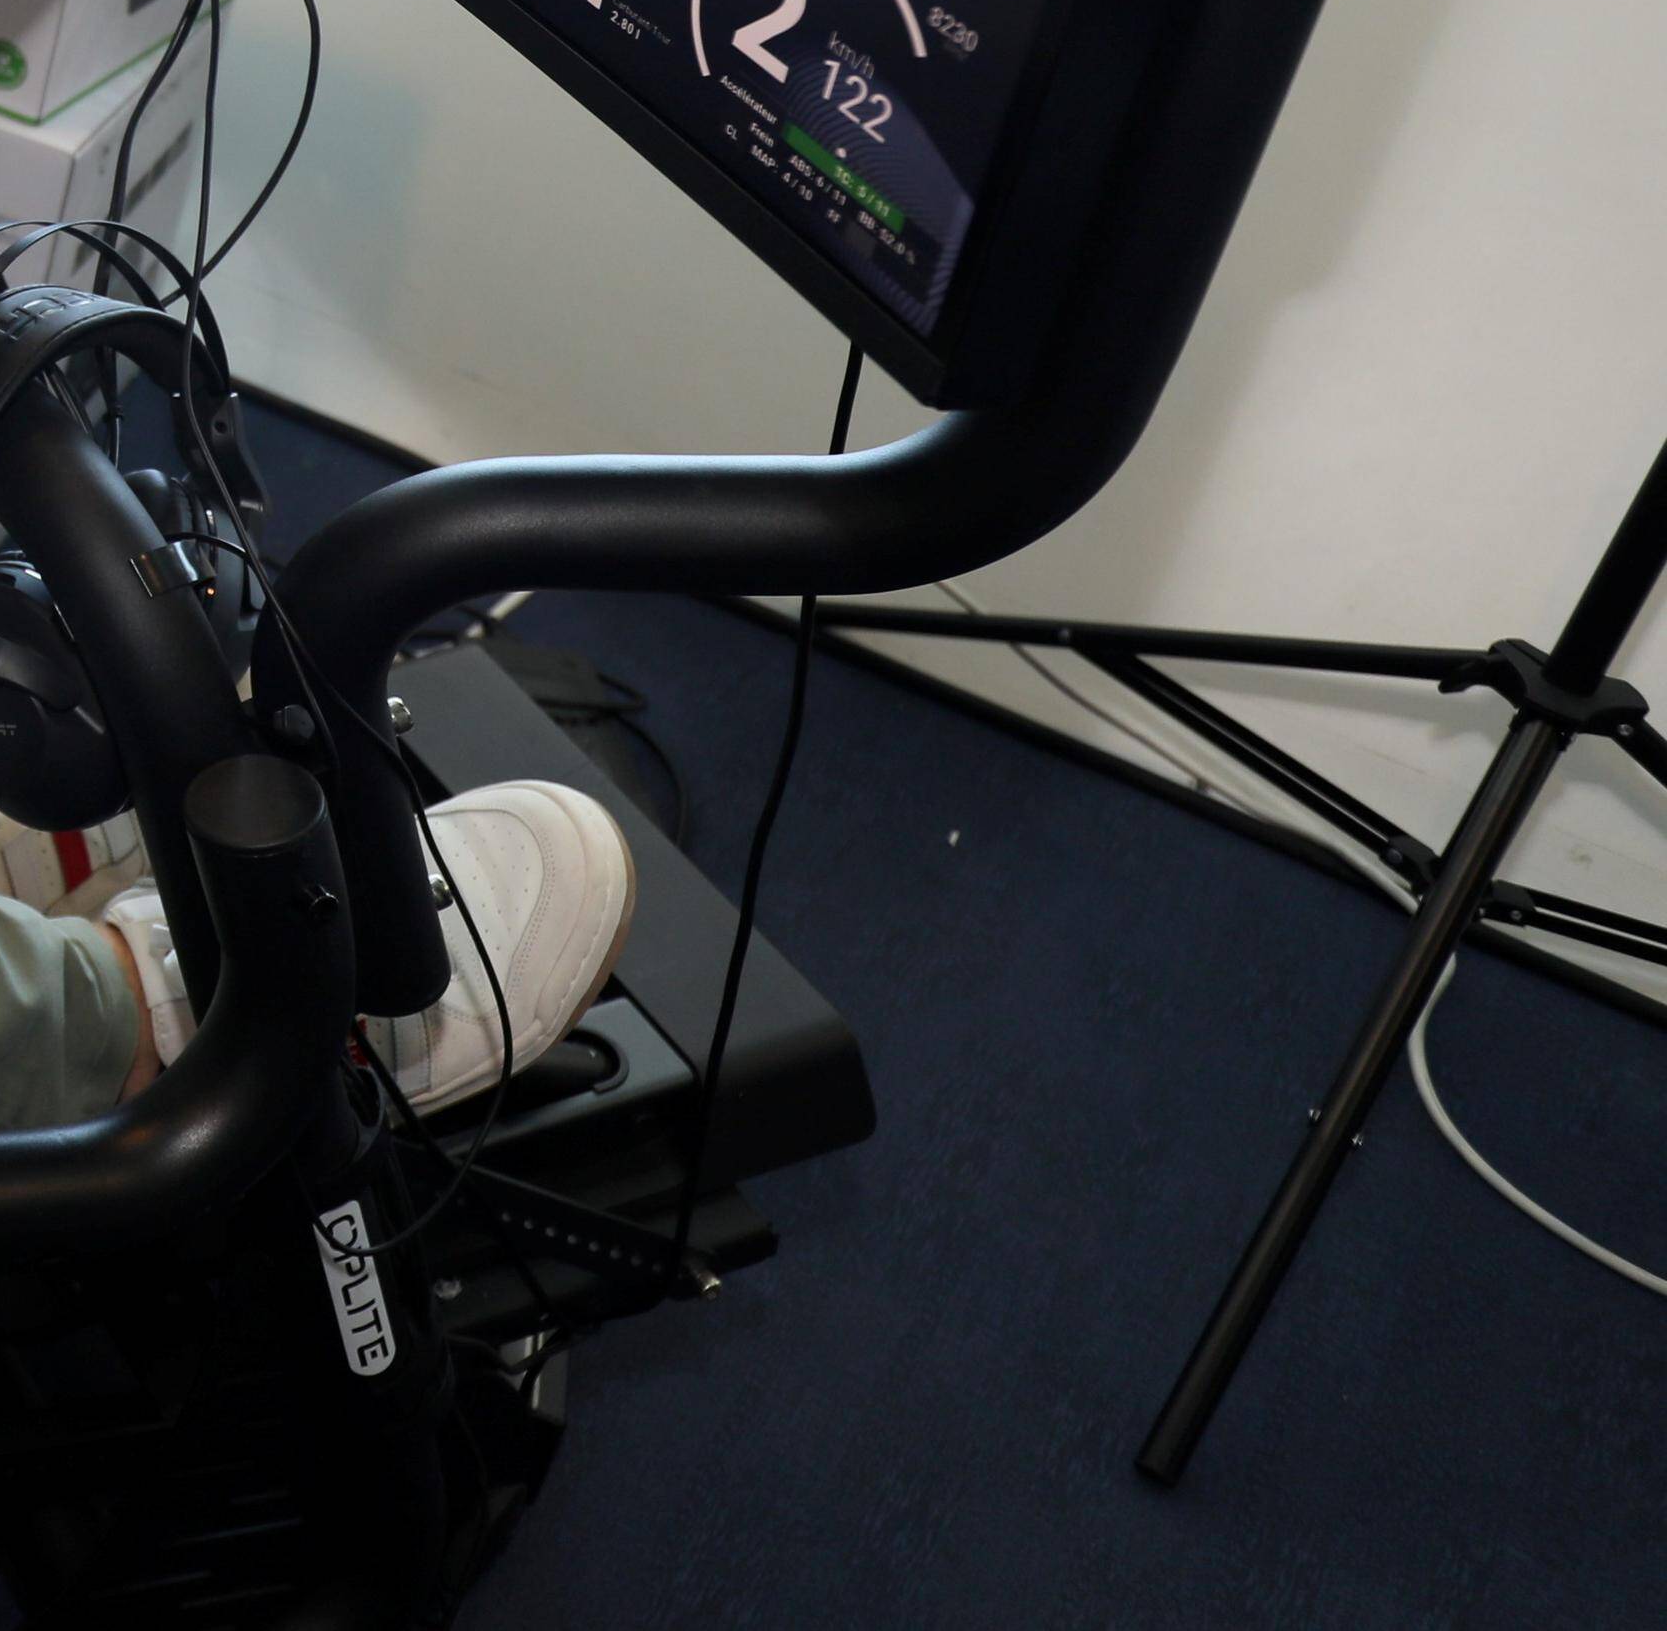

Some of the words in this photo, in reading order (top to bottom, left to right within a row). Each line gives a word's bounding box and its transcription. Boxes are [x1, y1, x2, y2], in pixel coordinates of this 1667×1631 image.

[610, 10, 635, 35] 2.80
[926, 6, 979, 52] 8230
[827, 30, 875, 79] km/h
[822, 60, 894, 144] 122
[750, 121, 775, 148] Frein
[323, 1212, 390, 1370] OPLITE
